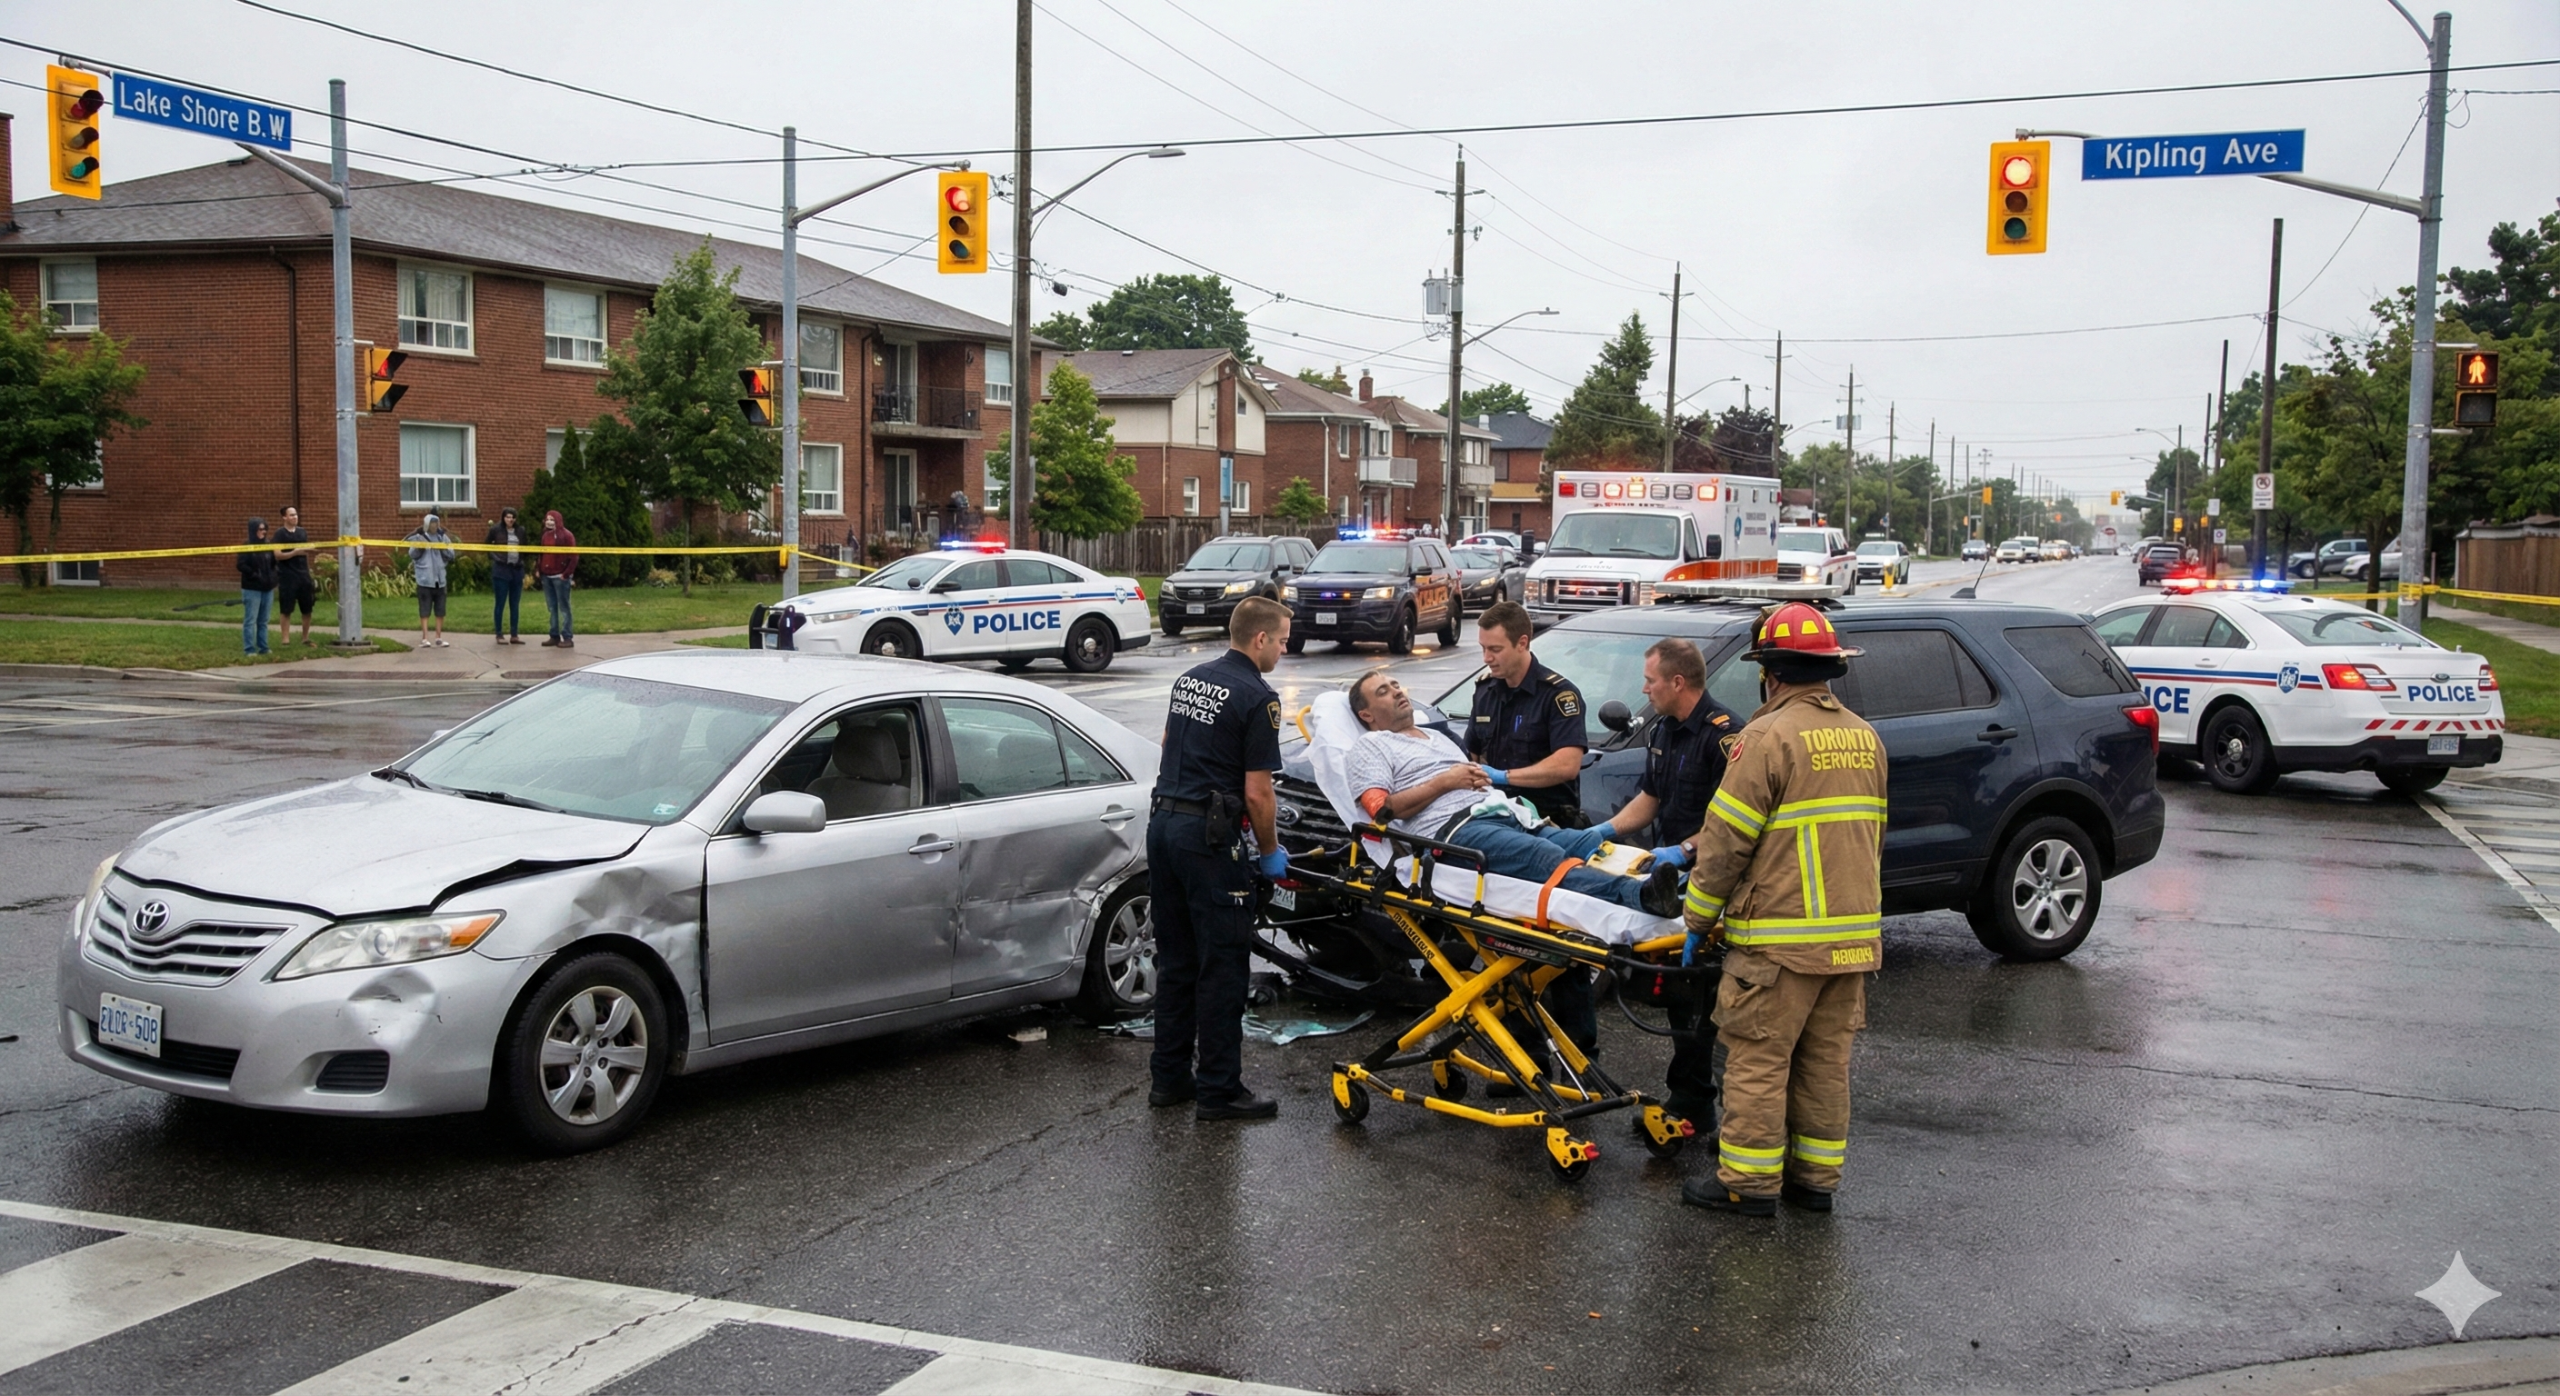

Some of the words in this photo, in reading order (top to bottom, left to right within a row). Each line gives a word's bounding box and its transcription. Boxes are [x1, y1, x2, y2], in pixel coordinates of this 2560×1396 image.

[120, 81, 171, 118] Lake
[181, 94, 239, 133] Shore
[2105, 140, 2206, 176] Kipling
[2222, 138, 2278, 165] Ave
[973, 610, 1061, 634] POLICE
[1176, 676, 1230, 701] TORONTO
[2407, 685, 2477, 702] POLICE
[1799, 727, 1877, 753] TORONTO
[1811, 751, 1876, 771] SERVICES
